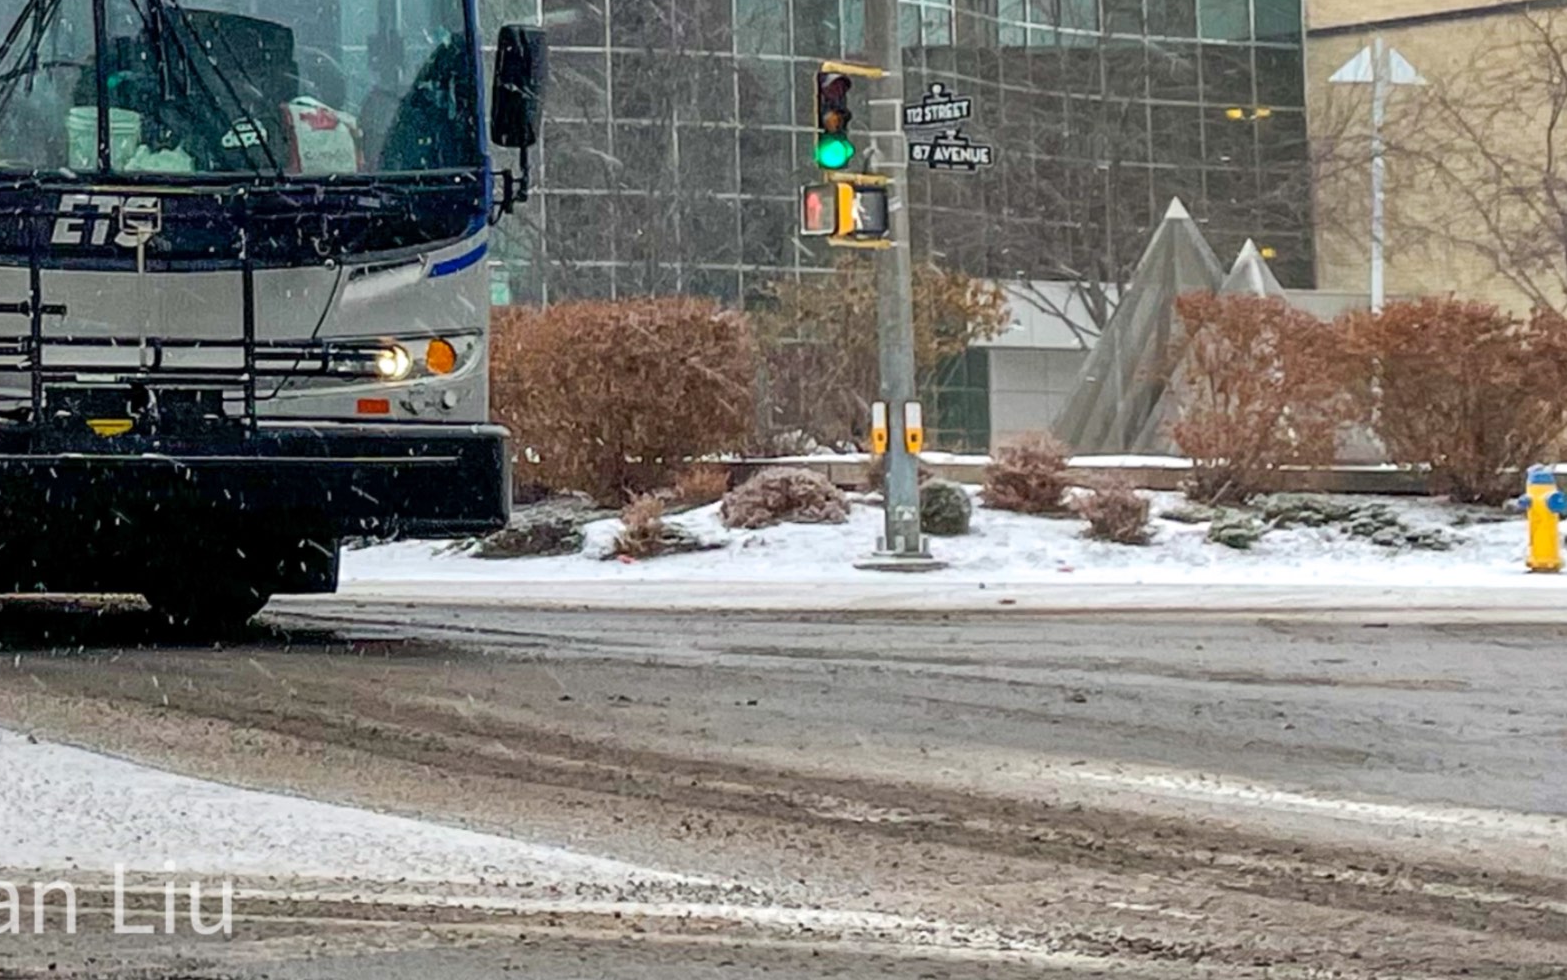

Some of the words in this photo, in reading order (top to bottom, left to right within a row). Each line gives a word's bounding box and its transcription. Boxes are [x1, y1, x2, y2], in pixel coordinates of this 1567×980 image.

[906, 107, 923, 123] 112
[924, 101, 969, 122] STREET
[912, 145, 931, 160] 87
[933, 146, 989, 163] AVENUE
[50, 194, 161, 246] ETS
